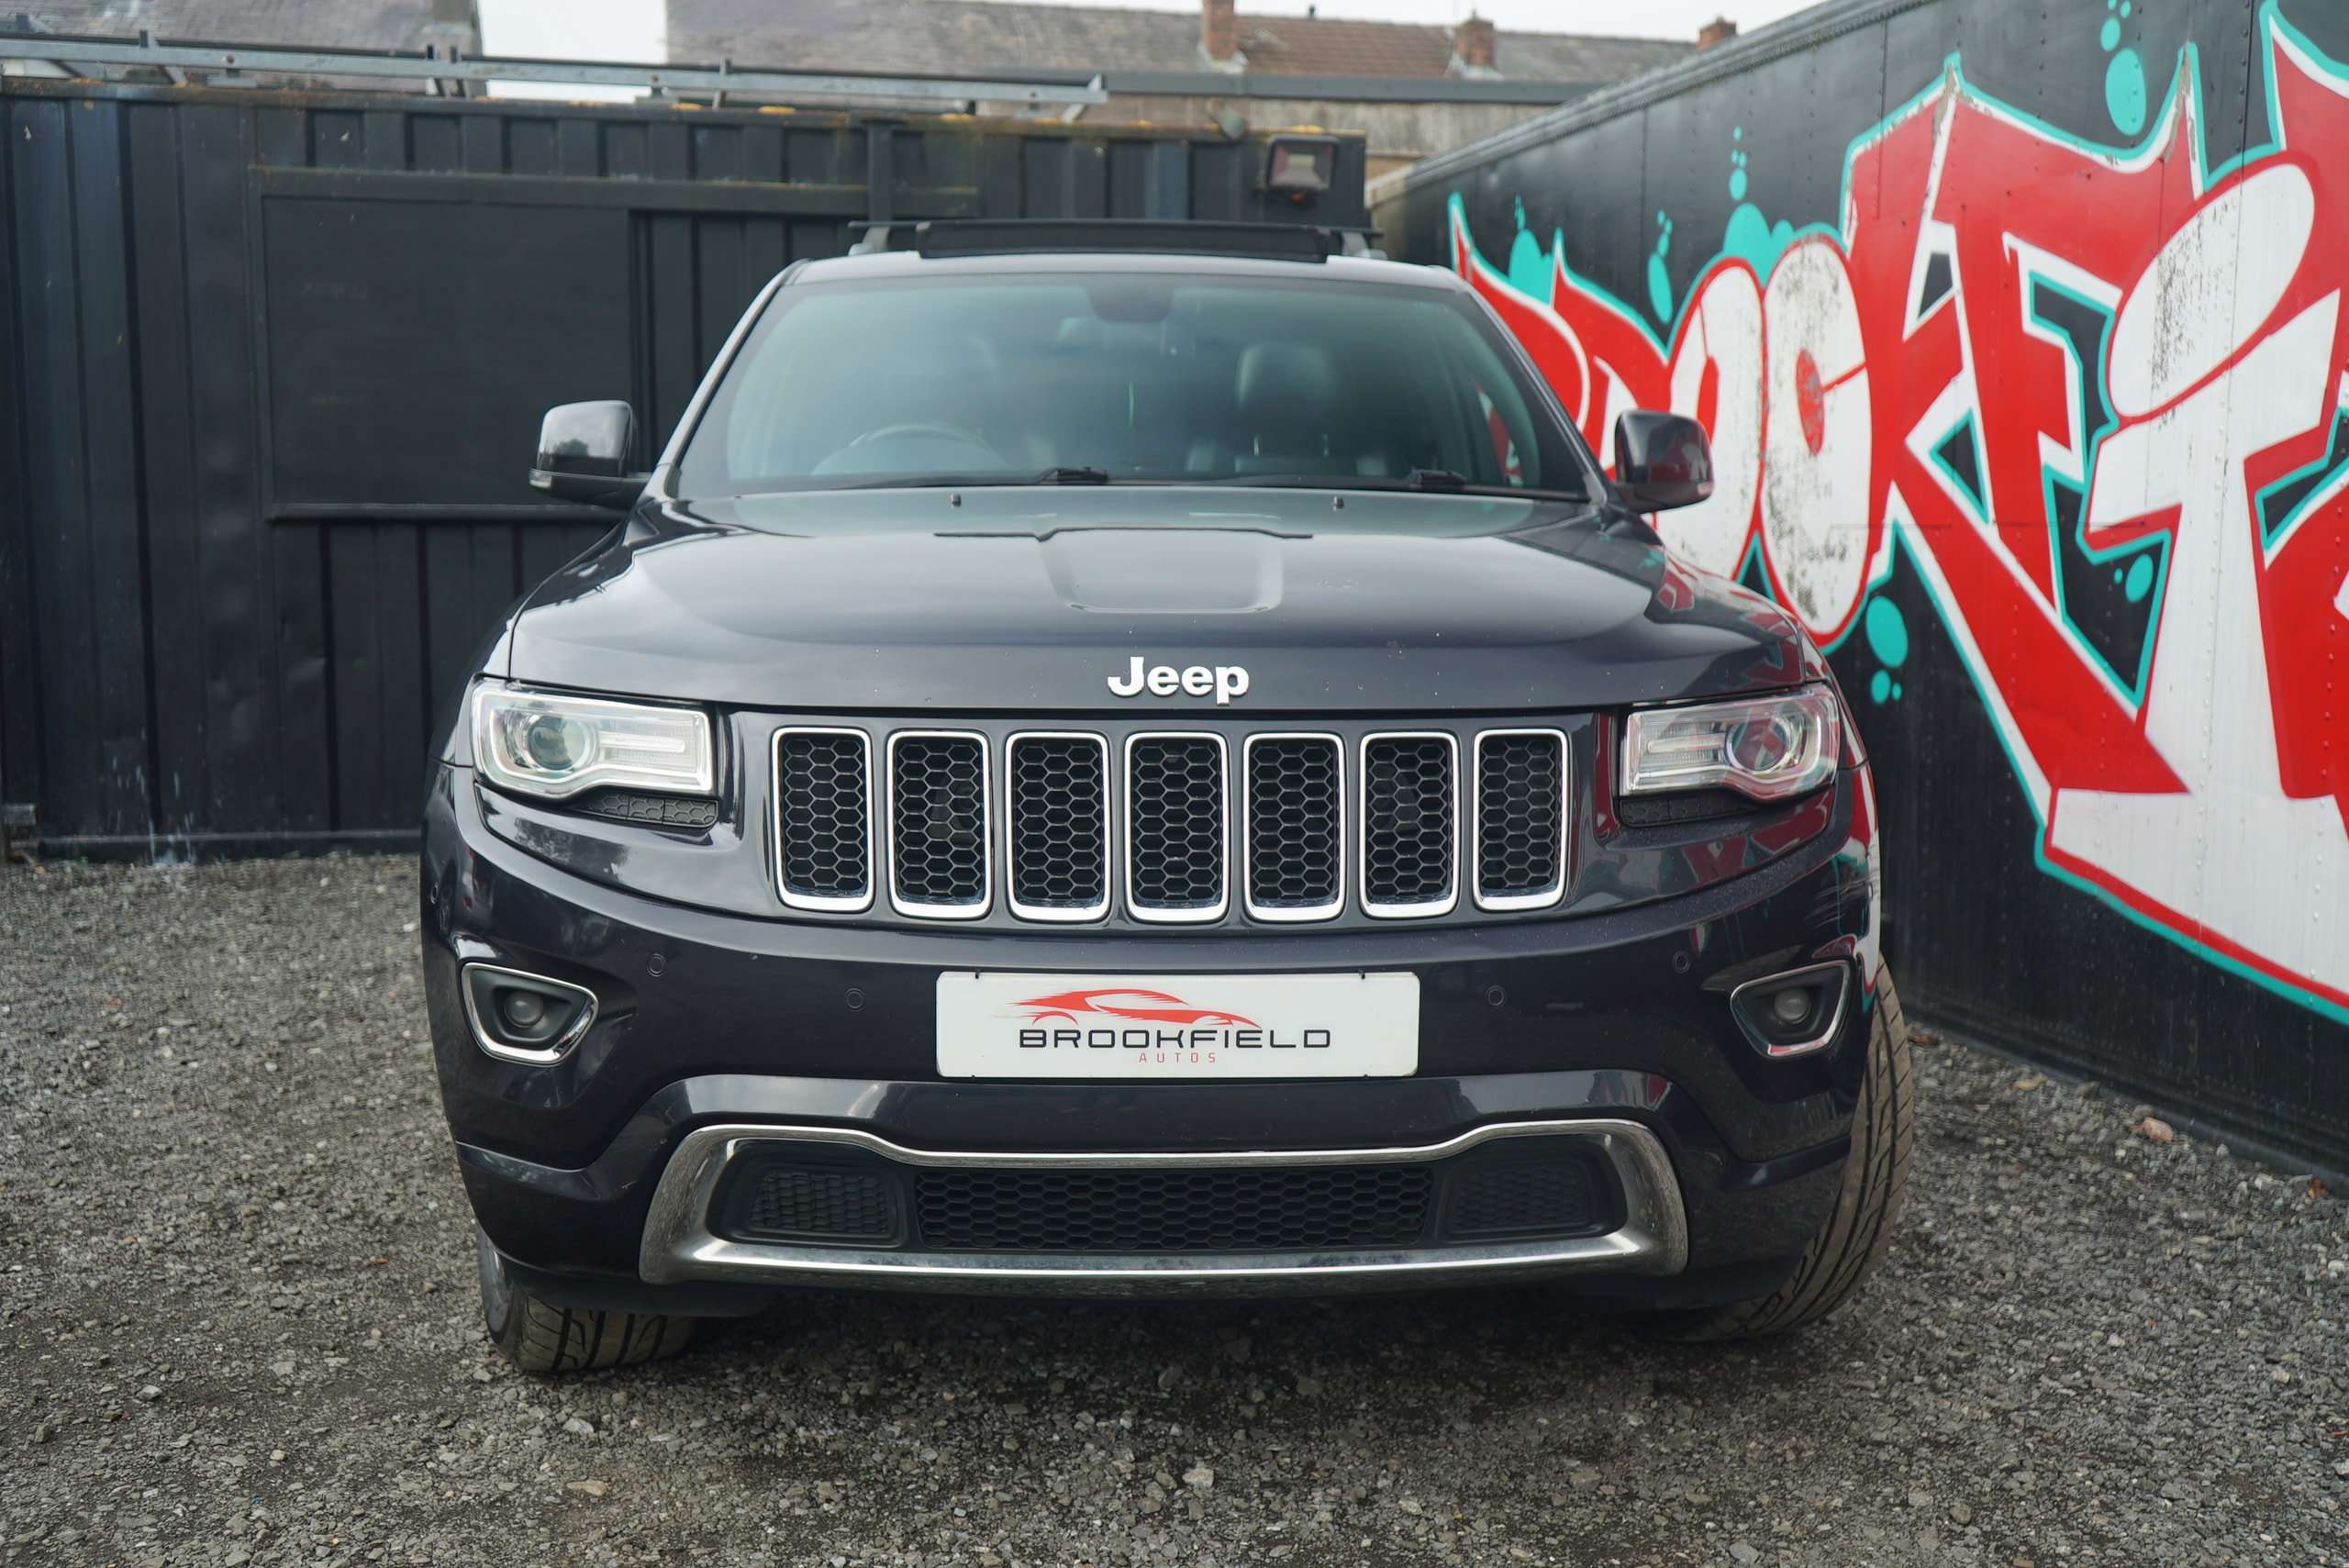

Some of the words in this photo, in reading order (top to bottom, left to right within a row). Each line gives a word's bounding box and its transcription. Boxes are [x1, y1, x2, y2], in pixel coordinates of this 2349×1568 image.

[1107, 656, 1250, 706] Jeep
[1019, 1029, 1331, 1049] BROOKFIELD
[1139, 1052, 1217, 1063] AUTOS
